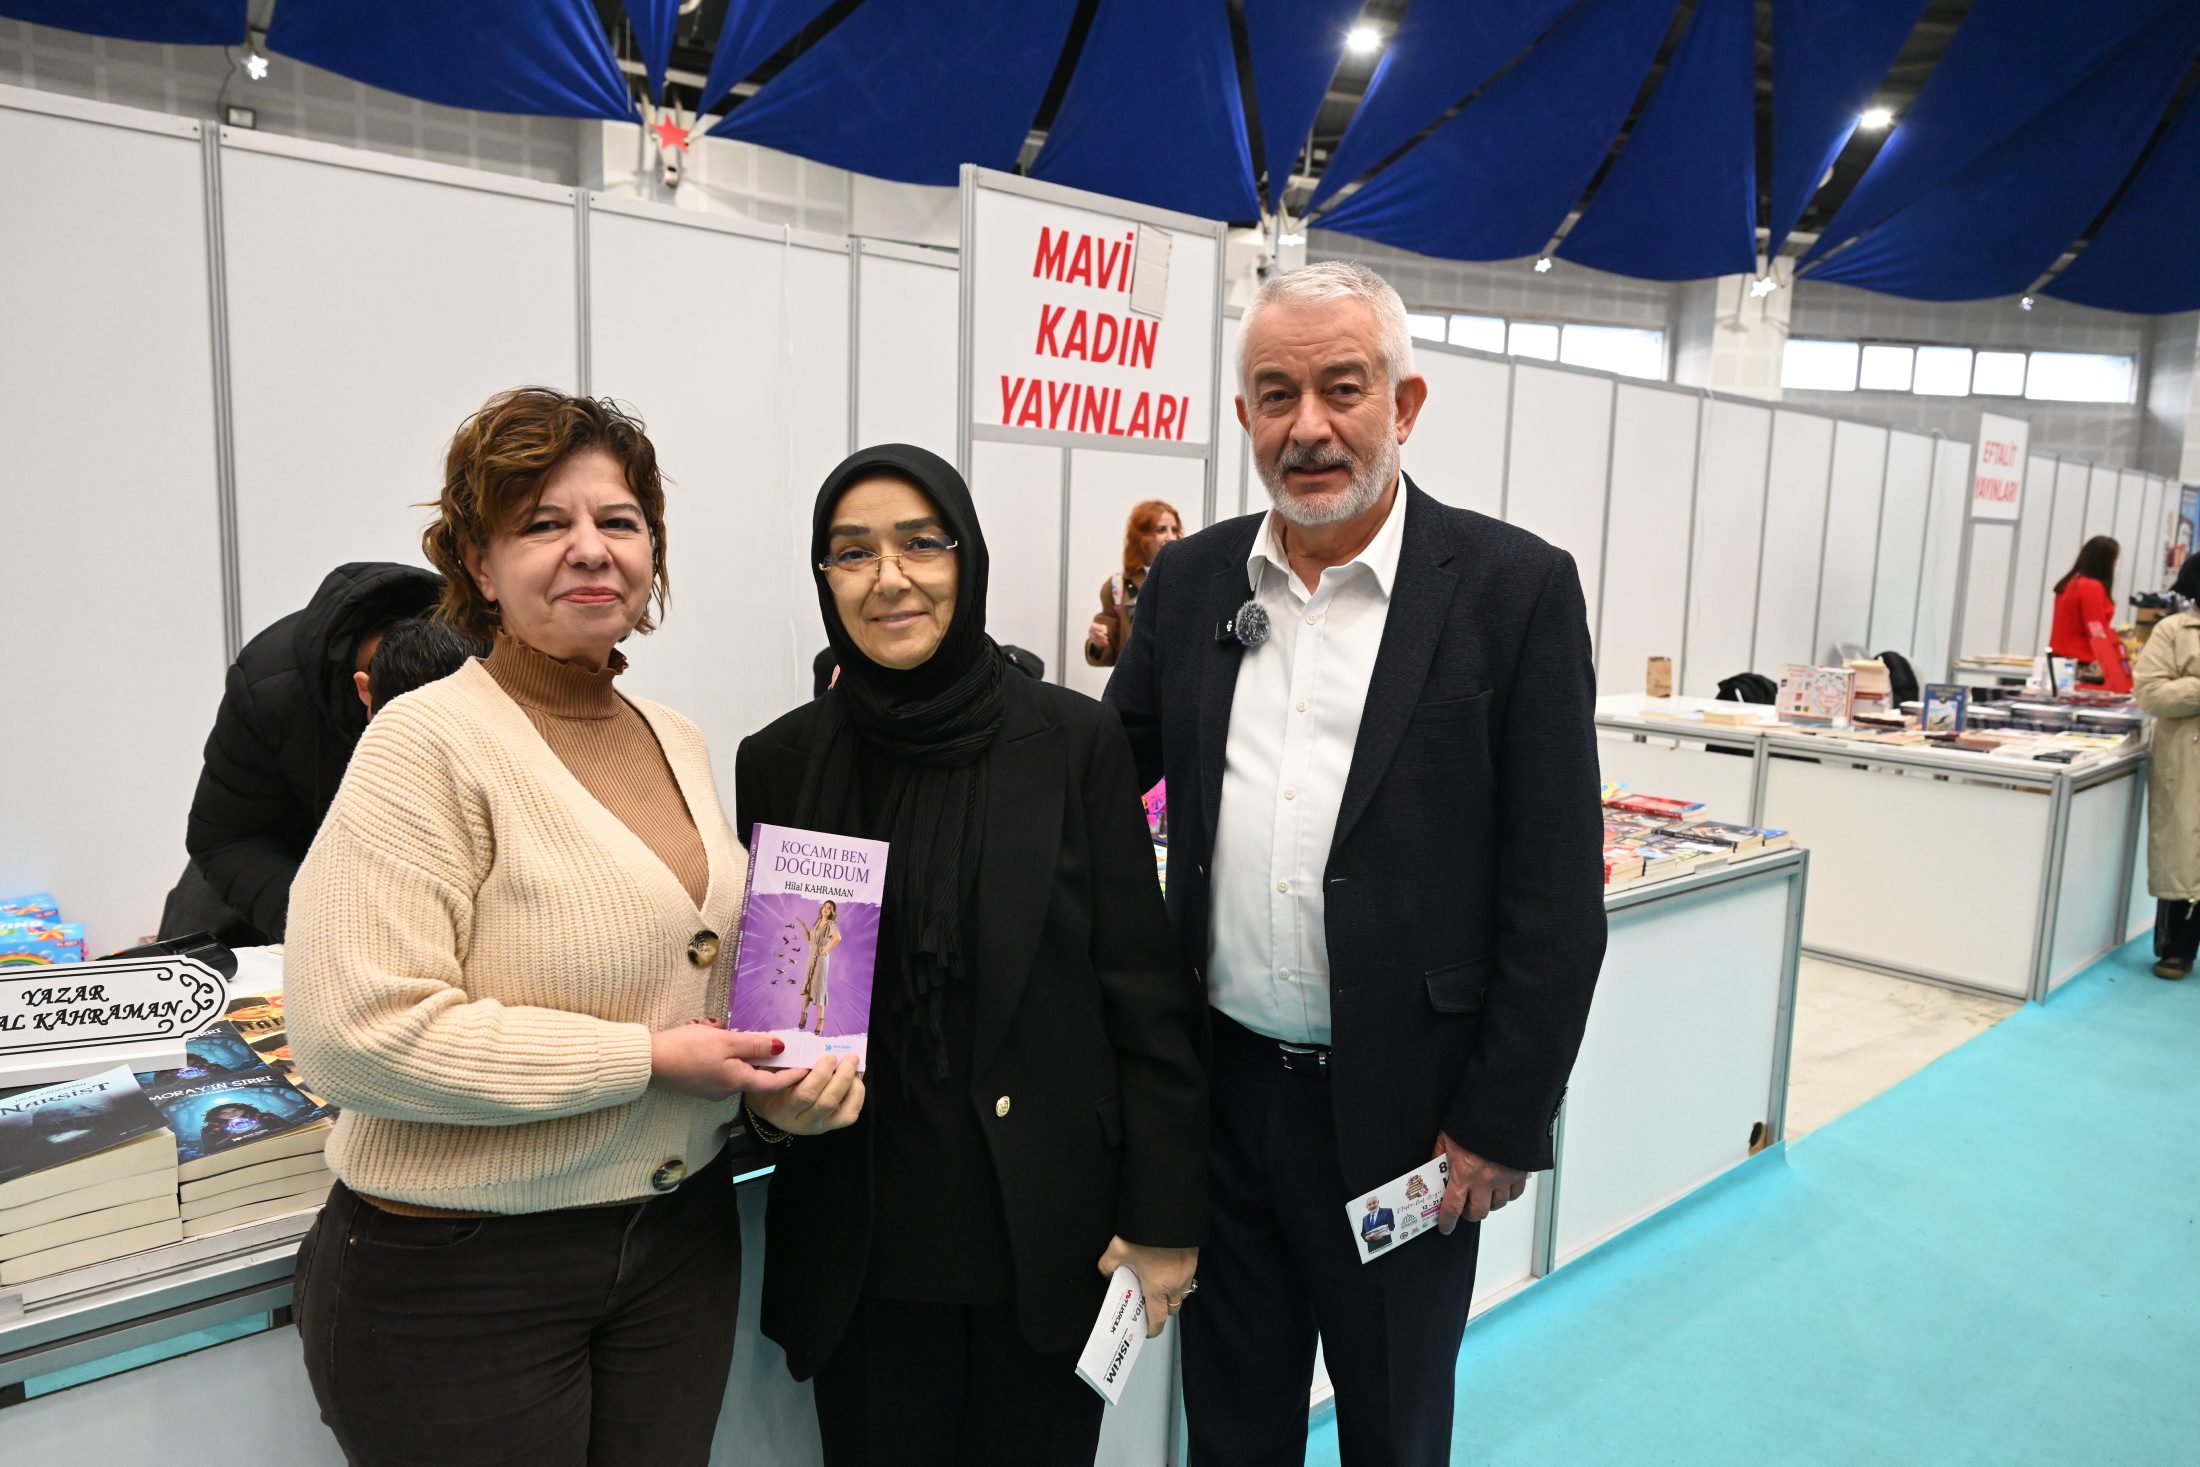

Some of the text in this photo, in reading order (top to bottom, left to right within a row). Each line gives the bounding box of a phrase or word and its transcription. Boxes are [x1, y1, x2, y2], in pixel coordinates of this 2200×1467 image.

[1033, 226, 1134, 294] MAVİ
[1036, 304, 1158, 369] KADIN
[1001, 375, 1189, 440] YAYINLARI
[781, 841, 868, 865] KOCAMI BEN
[774, 855, 870, 884] DOĞURDUM
[784, 880, 854, 898] Hilal KAHRAMAN
[21, 984, 110, 1007] YAZAR
[33, 1000, 183, 1031] KAHRAMAN
